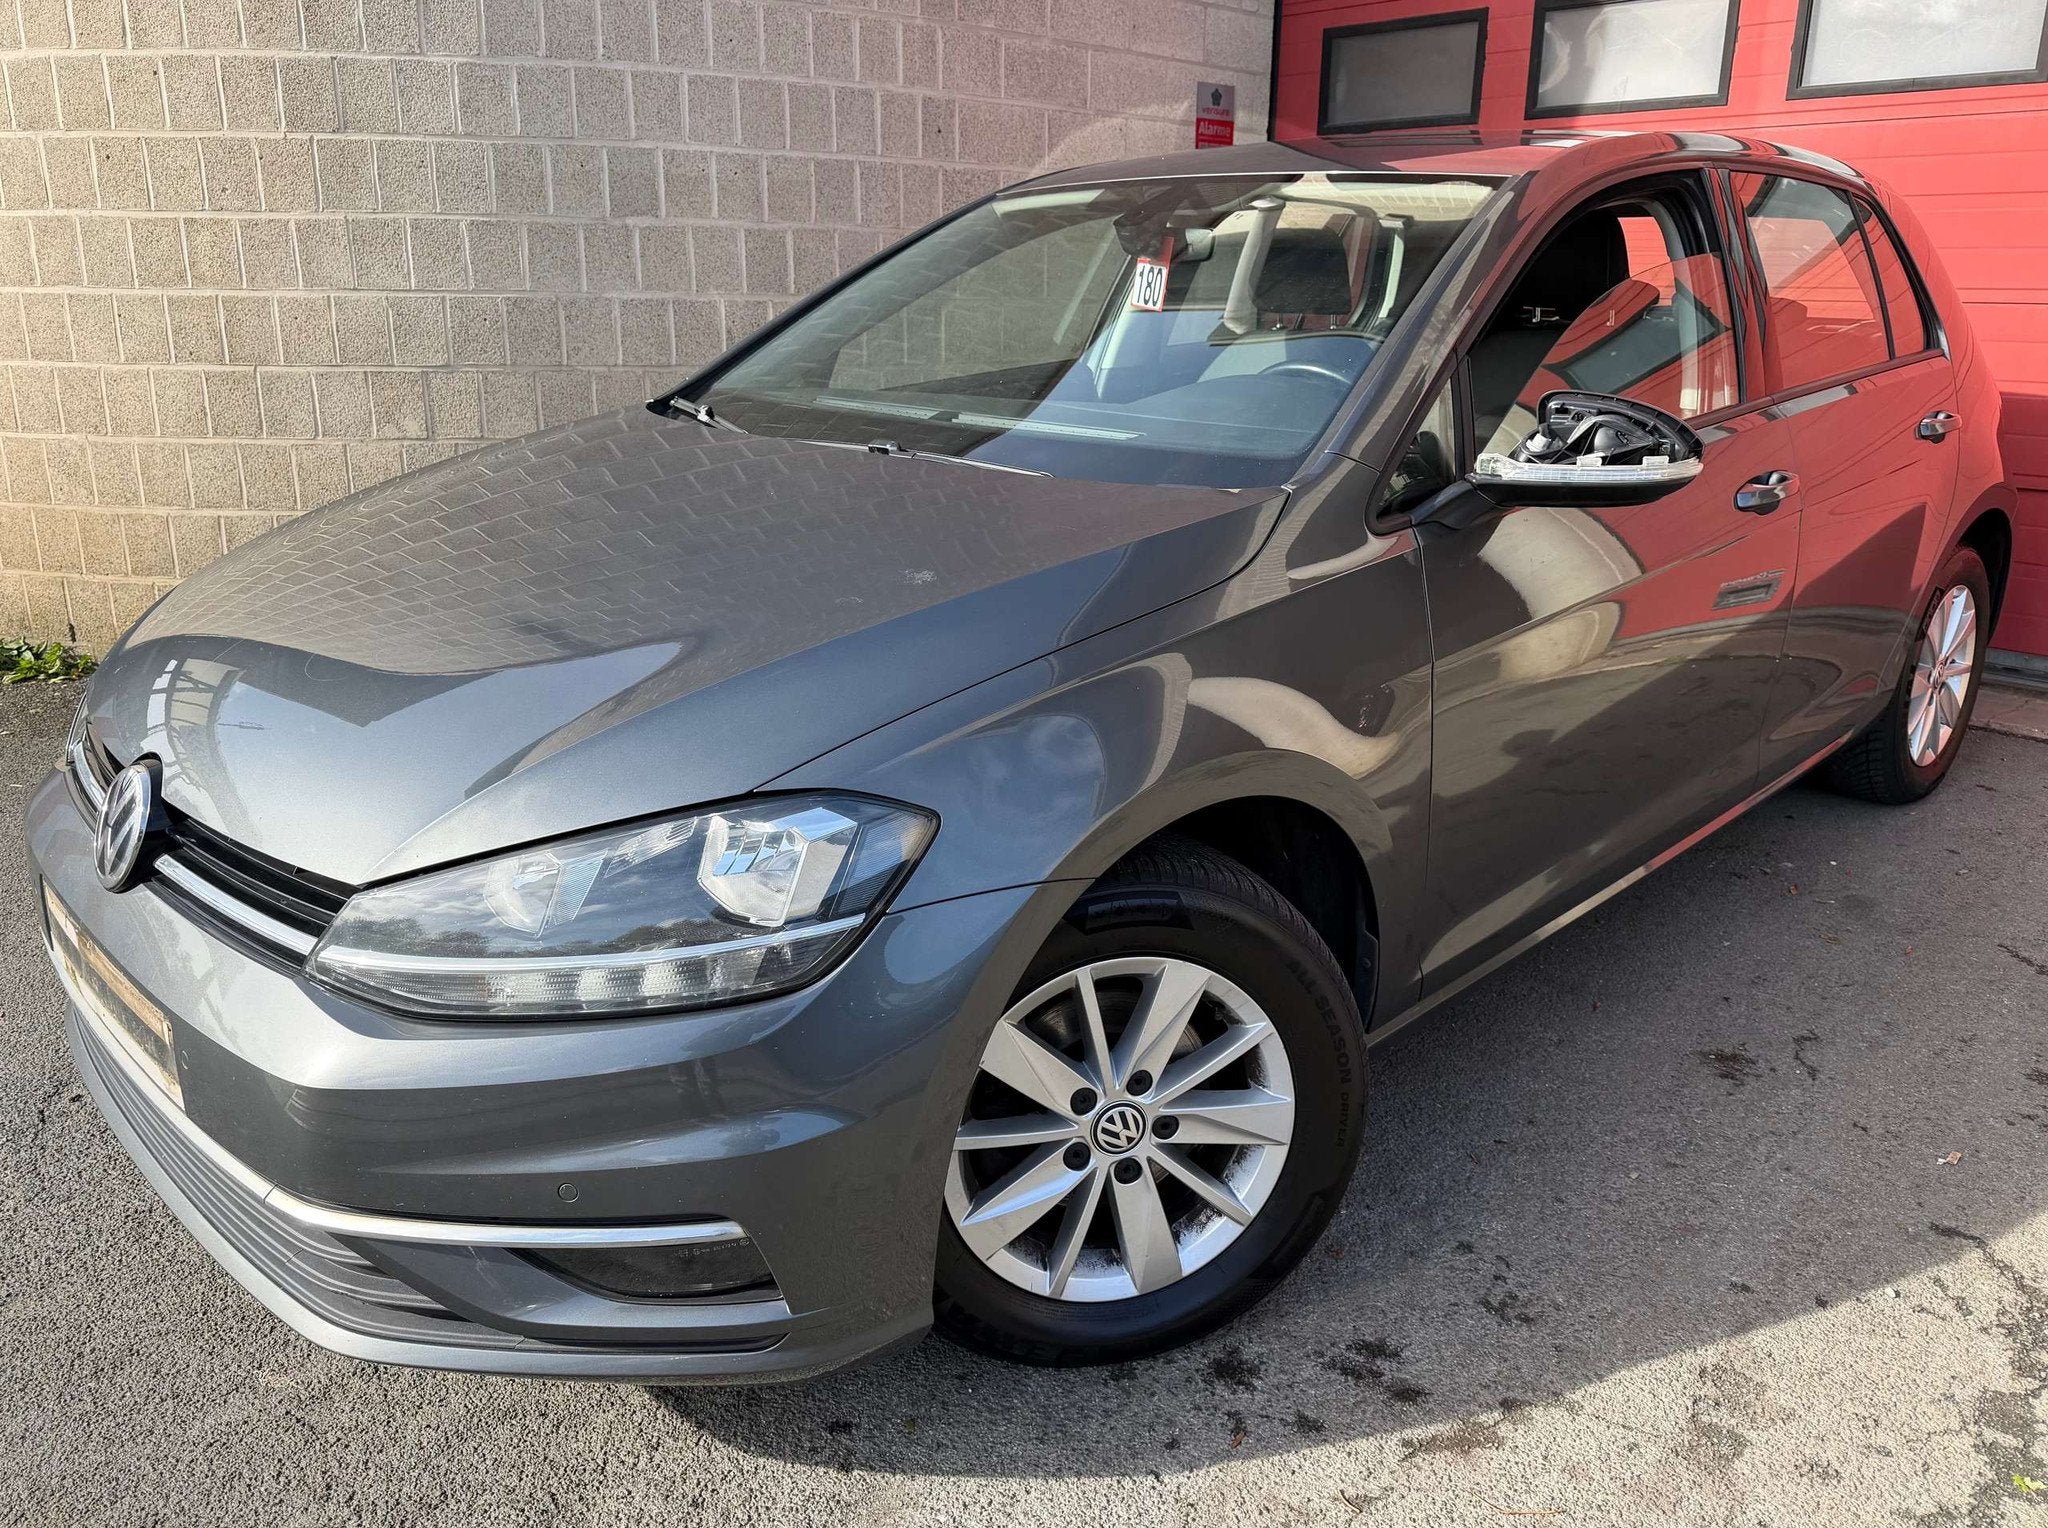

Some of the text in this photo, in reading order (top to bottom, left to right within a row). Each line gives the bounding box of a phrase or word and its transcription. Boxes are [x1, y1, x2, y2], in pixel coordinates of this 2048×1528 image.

[1198, 121, 1231, 137] Alarme
[1136, 265, 1163, 307] 180
[1314, 994, 1352, 1085] SEASON
